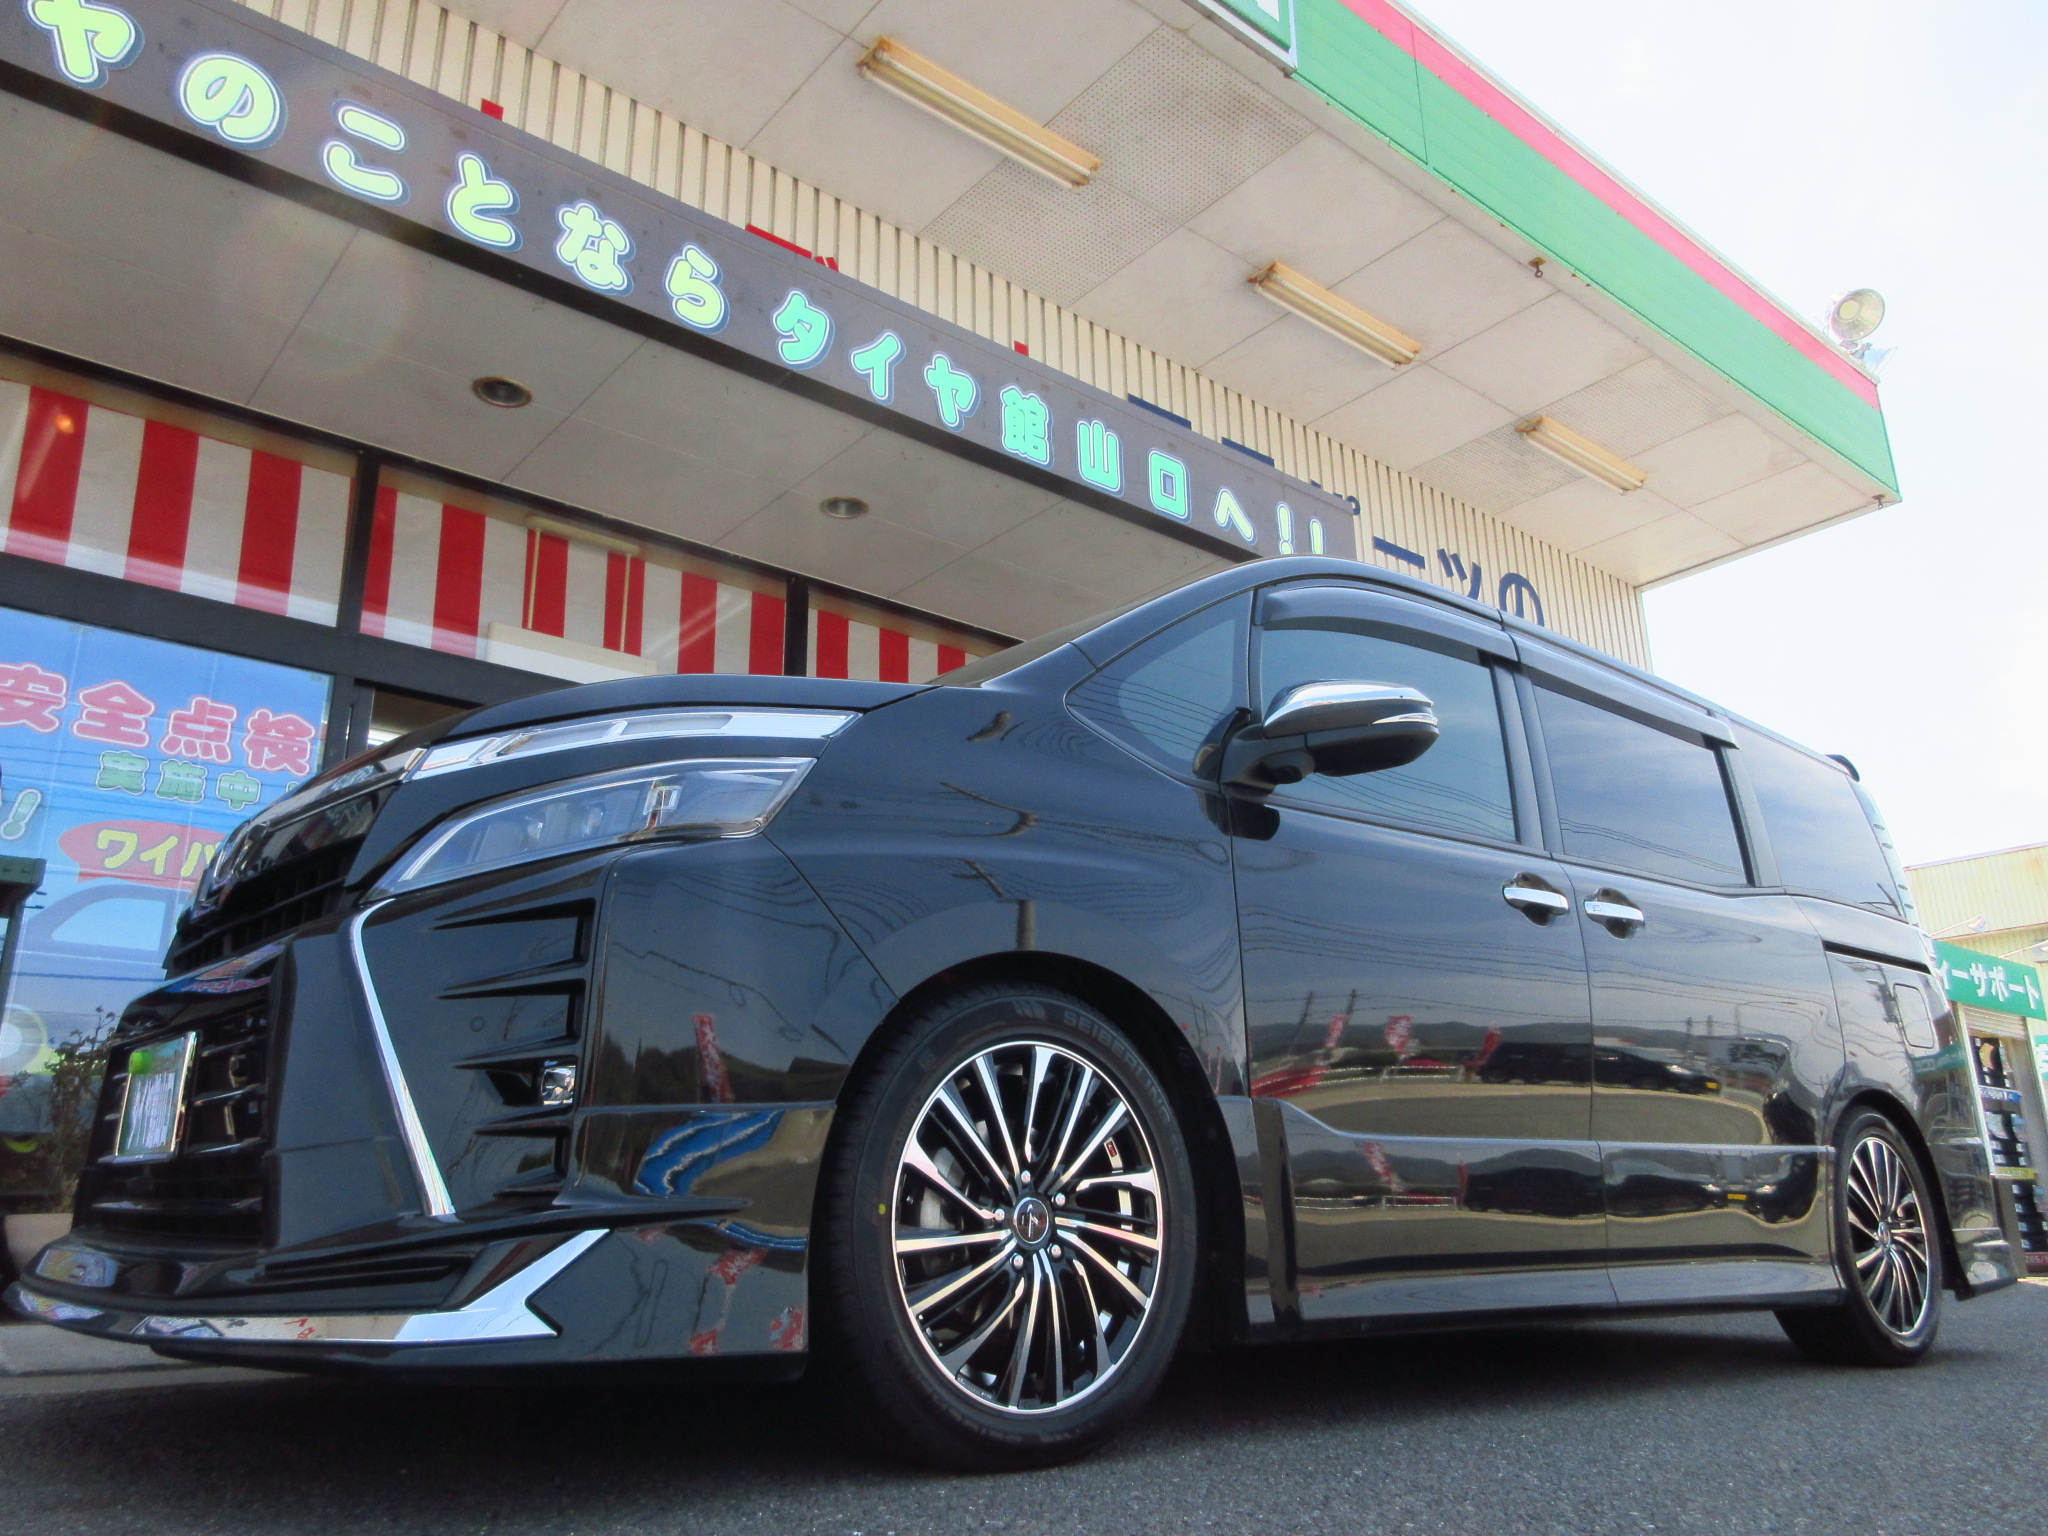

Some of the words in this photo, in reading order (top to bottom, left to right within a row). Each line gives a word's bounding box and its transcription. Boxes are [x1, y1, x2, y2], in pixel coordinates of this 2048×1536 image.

[0, 662, 316, 777] 安全点検
[95, 750, 300, 811] 実施中
[1062, 1009, 1172, 1125] SEIBERLING
